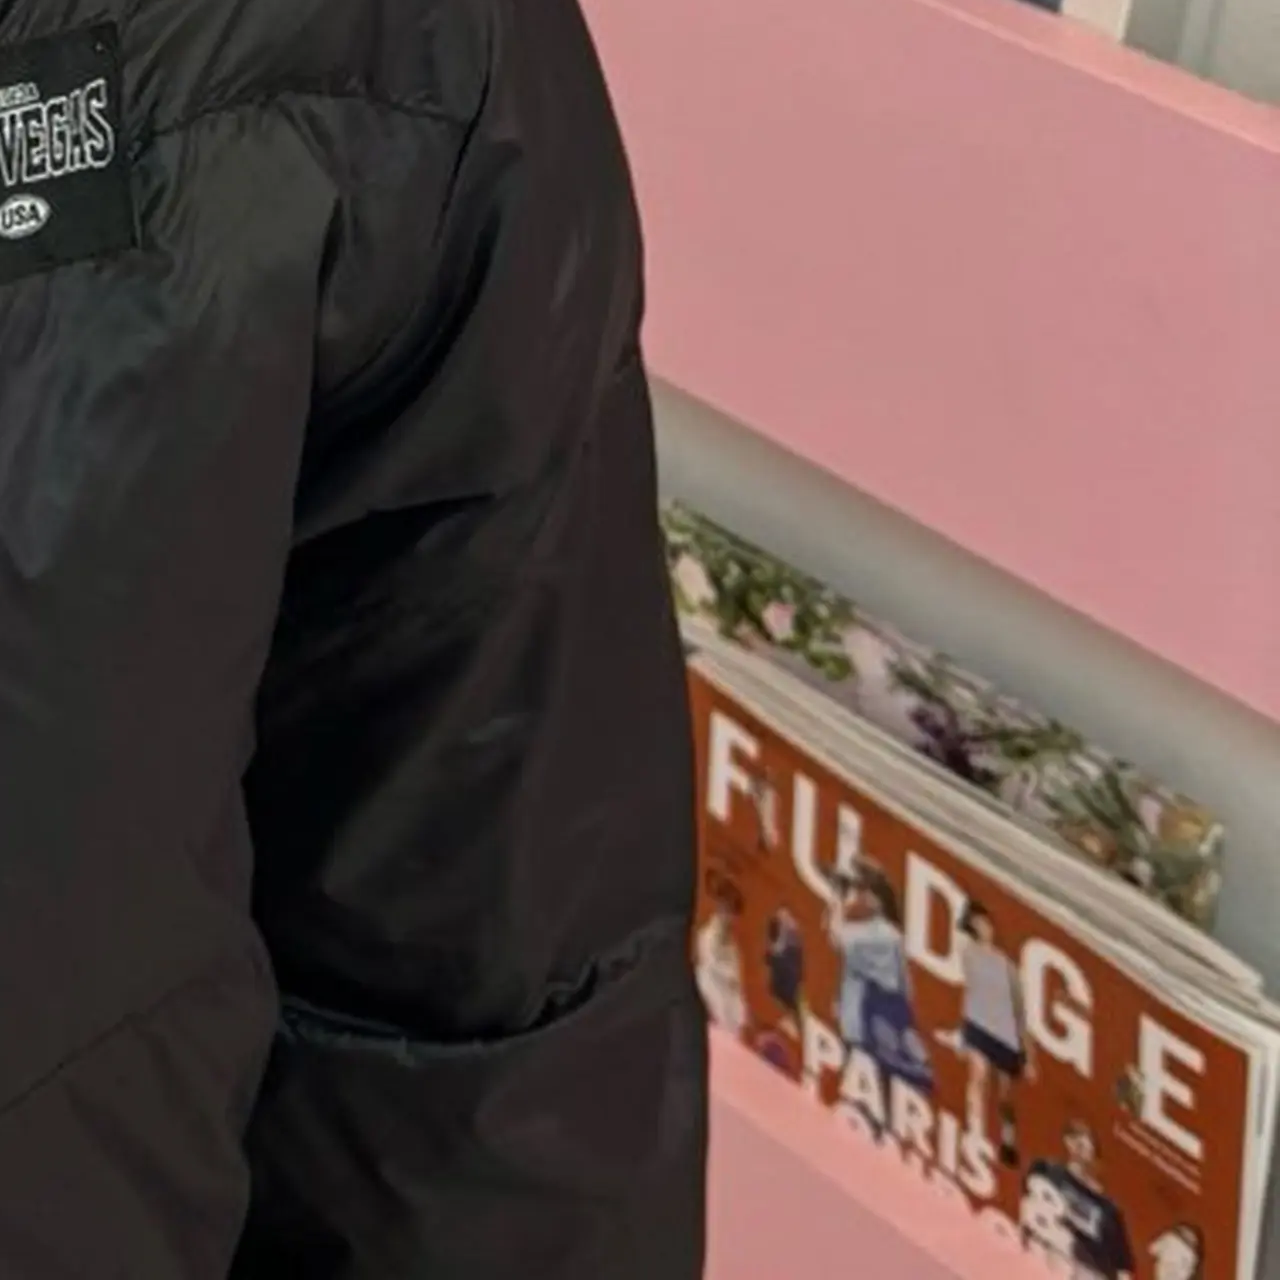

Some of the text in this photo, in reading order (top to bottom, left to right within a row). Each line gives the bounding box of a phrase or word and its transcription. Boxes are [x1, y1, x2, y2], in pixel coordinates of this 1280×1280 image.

[0, 203, 42, 230] USA
[707, 710, 1206, 1161] FUDGE
[803, 1014, 998, 1198] PARIS
